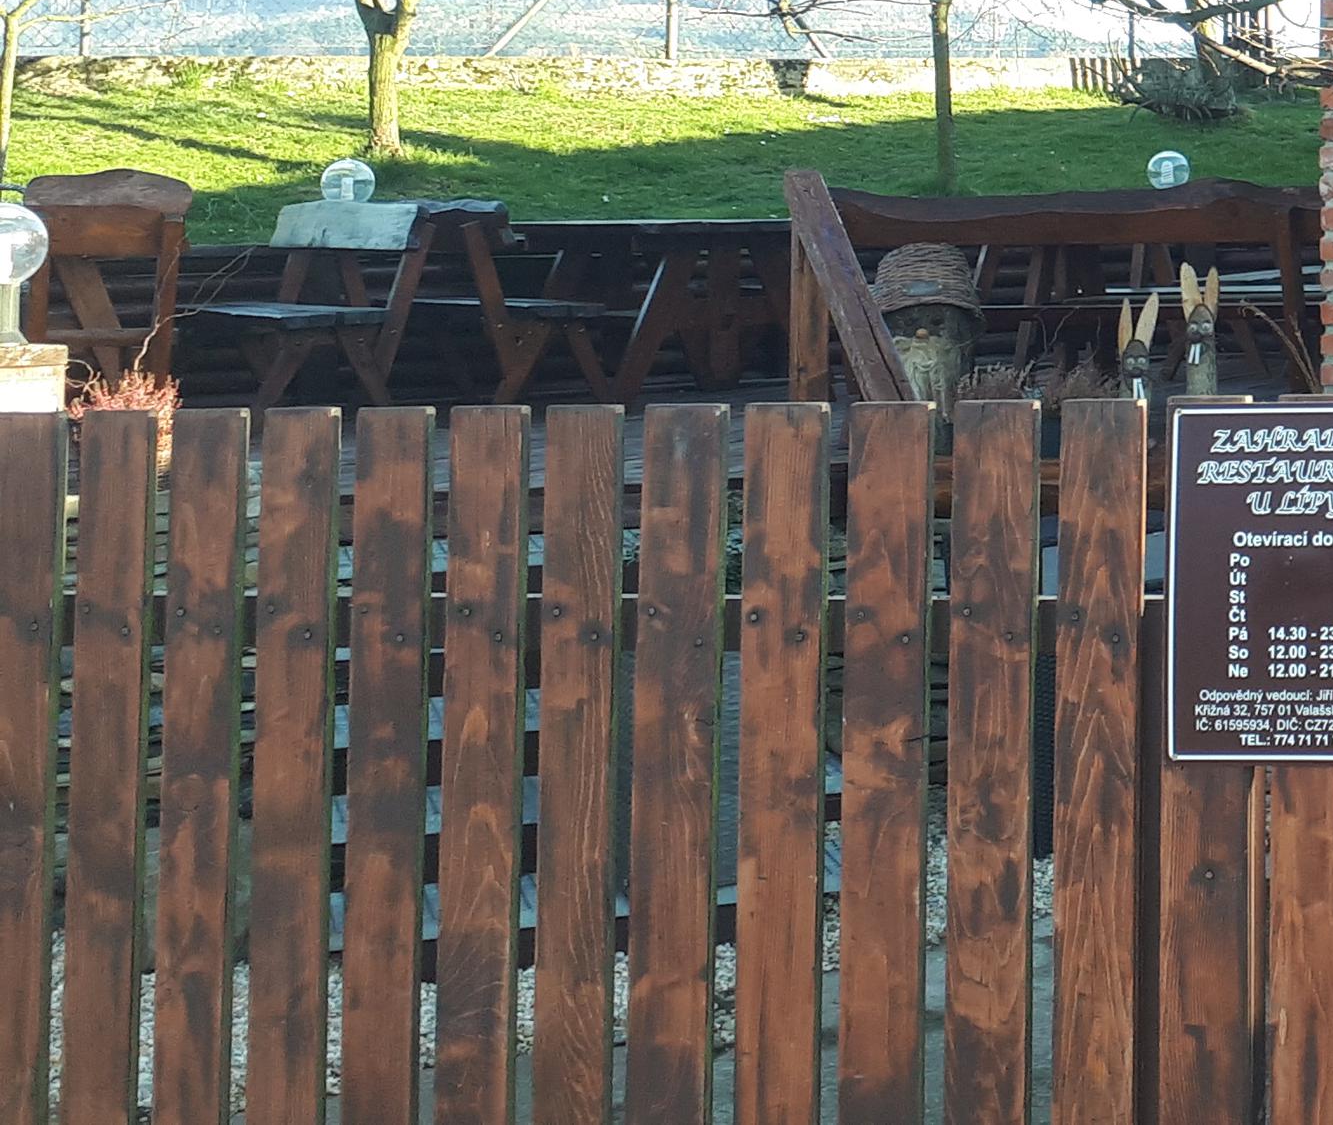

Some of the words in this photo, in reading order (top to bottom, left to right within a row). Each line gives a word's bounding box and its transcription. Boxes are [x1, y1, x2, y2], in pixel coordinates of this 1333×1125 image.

[1246, 491, 1272, 515] U
[1233, 531, 1308, 547] Otevírací
[1230, 553, 1250, 567] Po
[1230, 569, 1246, 585] Út
[1229, 590, 1245, 604] St
[1229, 605, 1246, 622] Čt
[1229, 626, 1248, 640] Pá
[1268, 626, 1307, 640] 14.30
[1229, 645, 1248, 659] So
[1268, 645, 1306, 659] 12.00
[1228, 664, 1248, 677] Ne
[1268, 663, 1306, 677] 12.00
[1199, 689, 1263, 703] Odpovědný
[1266, 689, 1313, 701] vedoucí:
[1233, 704, 1250, 717] 32,
[1254, 704, 1275, 716] 757
[1278, 704, 1291, 716] 01
[1196, 717, 1211, 731] IČ:
[1215, 719, 1273, 732] 61595934,
[1277, 717, 1302, 731] DIČ:
[1239, 734, 1270, 746] TEL.:
[1274, 734, 1295, 746] 774
[1298, 734, 1311, 746] 71
[1315, 734, 1328, 746] 71
